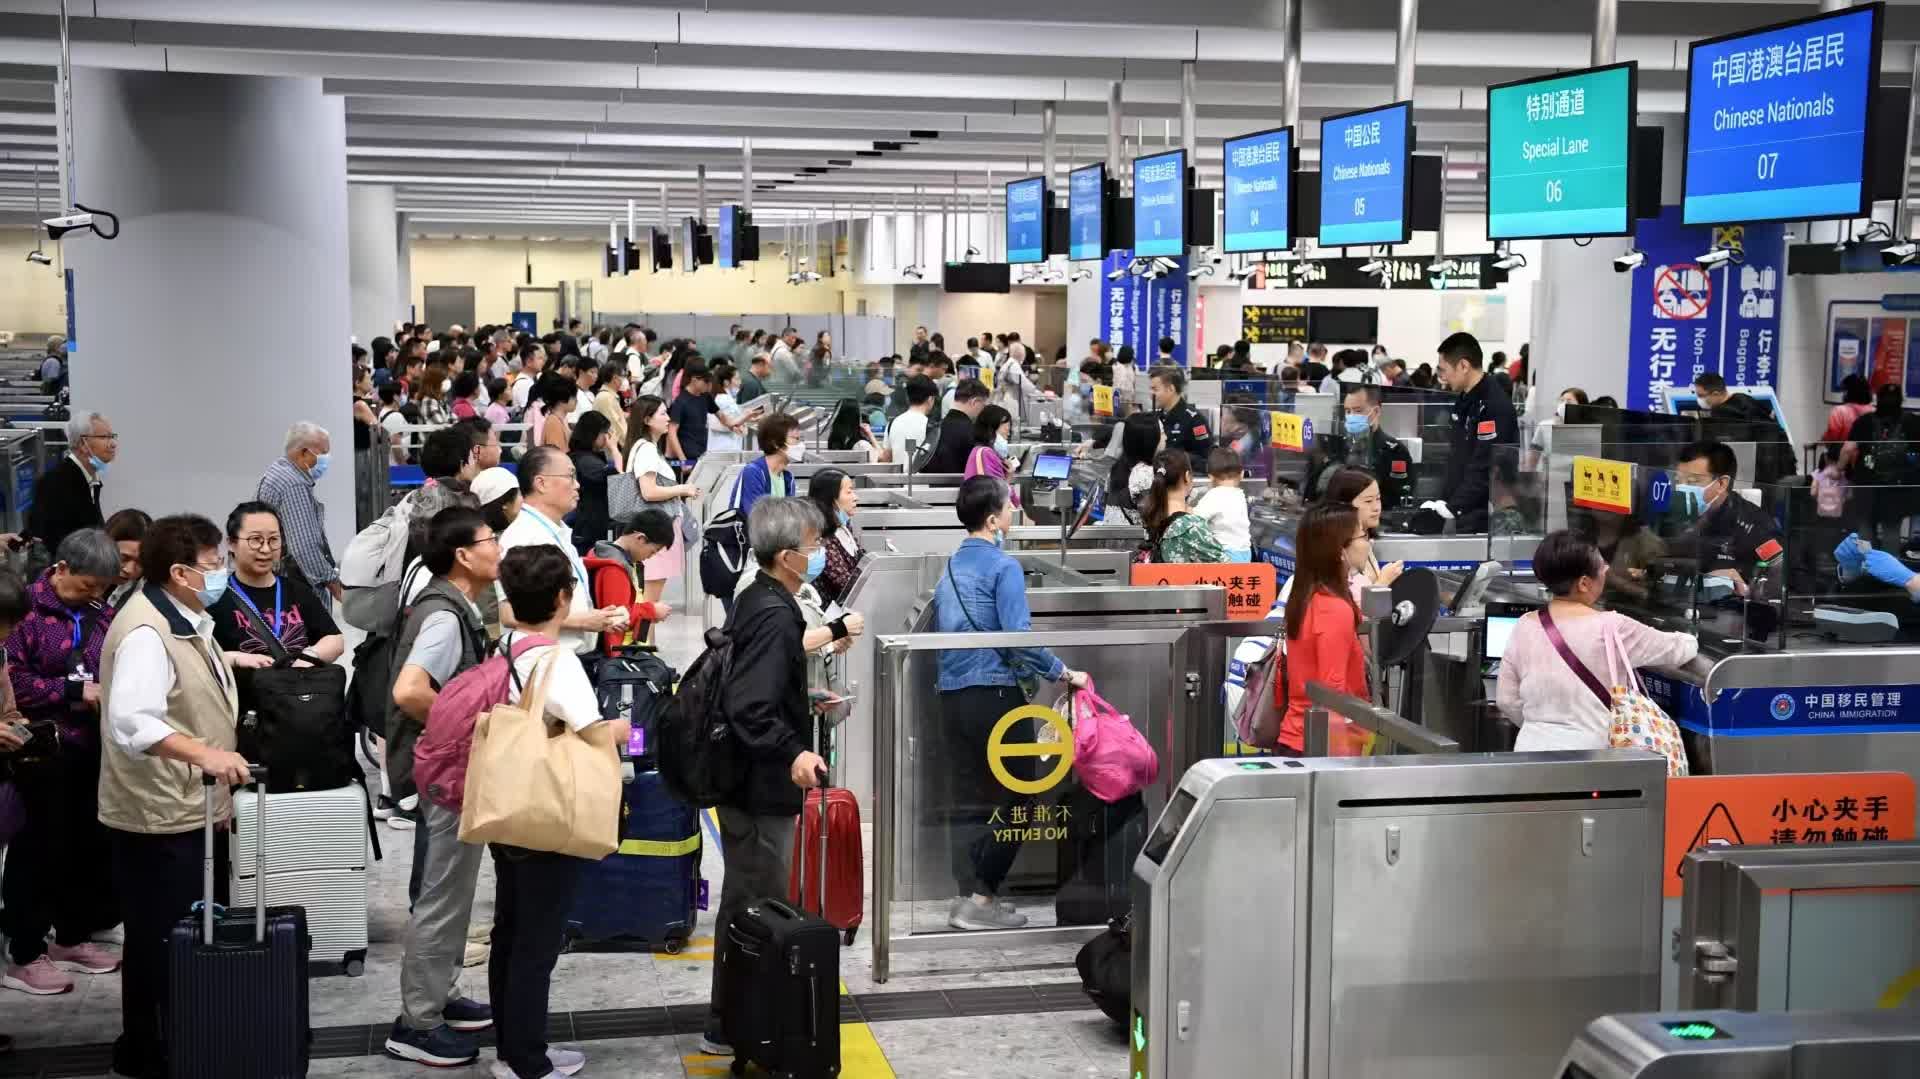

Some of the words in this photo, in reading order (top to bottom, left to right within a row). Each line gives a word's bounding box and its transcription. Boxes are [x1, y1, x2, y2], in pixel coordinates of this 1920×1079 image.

[1711, 32, 1845, 89] 中国港澳台居民
[1526, 87, 1585, 122] 特别通道
[1714, 107, 1764, 131] Chinese
[1768, 92, 1835, 124] Nationals
[1344, 121, 1381, 148] 中国公民
[1232, 141, 1280, 168] 中国港澳台居民
[1522, 137, 1560, 162] Special
[1562, 137, 1589, 155] Lane
[1333, 165, 1358, 182] Chinese
[1359, 159, 1391, 178] Nationals
[1757, 152, 1779, 180] 07
[1546, 180, 1563, 203] 06
[1251, 208, 1259, 226] 04
[1354, 197, 1366, 216] 05
[1303, 425, 1312, 440] 05
[1653, 481, 1668, 501] 07
[1804, 691, 1902, 709] 中国移民管理
[1808, 710, 1835, 719] CHINA
[1839, 709, 1897, 719] IMMIGRATION
[1771, 795, 1889, 822] 小心夹手
